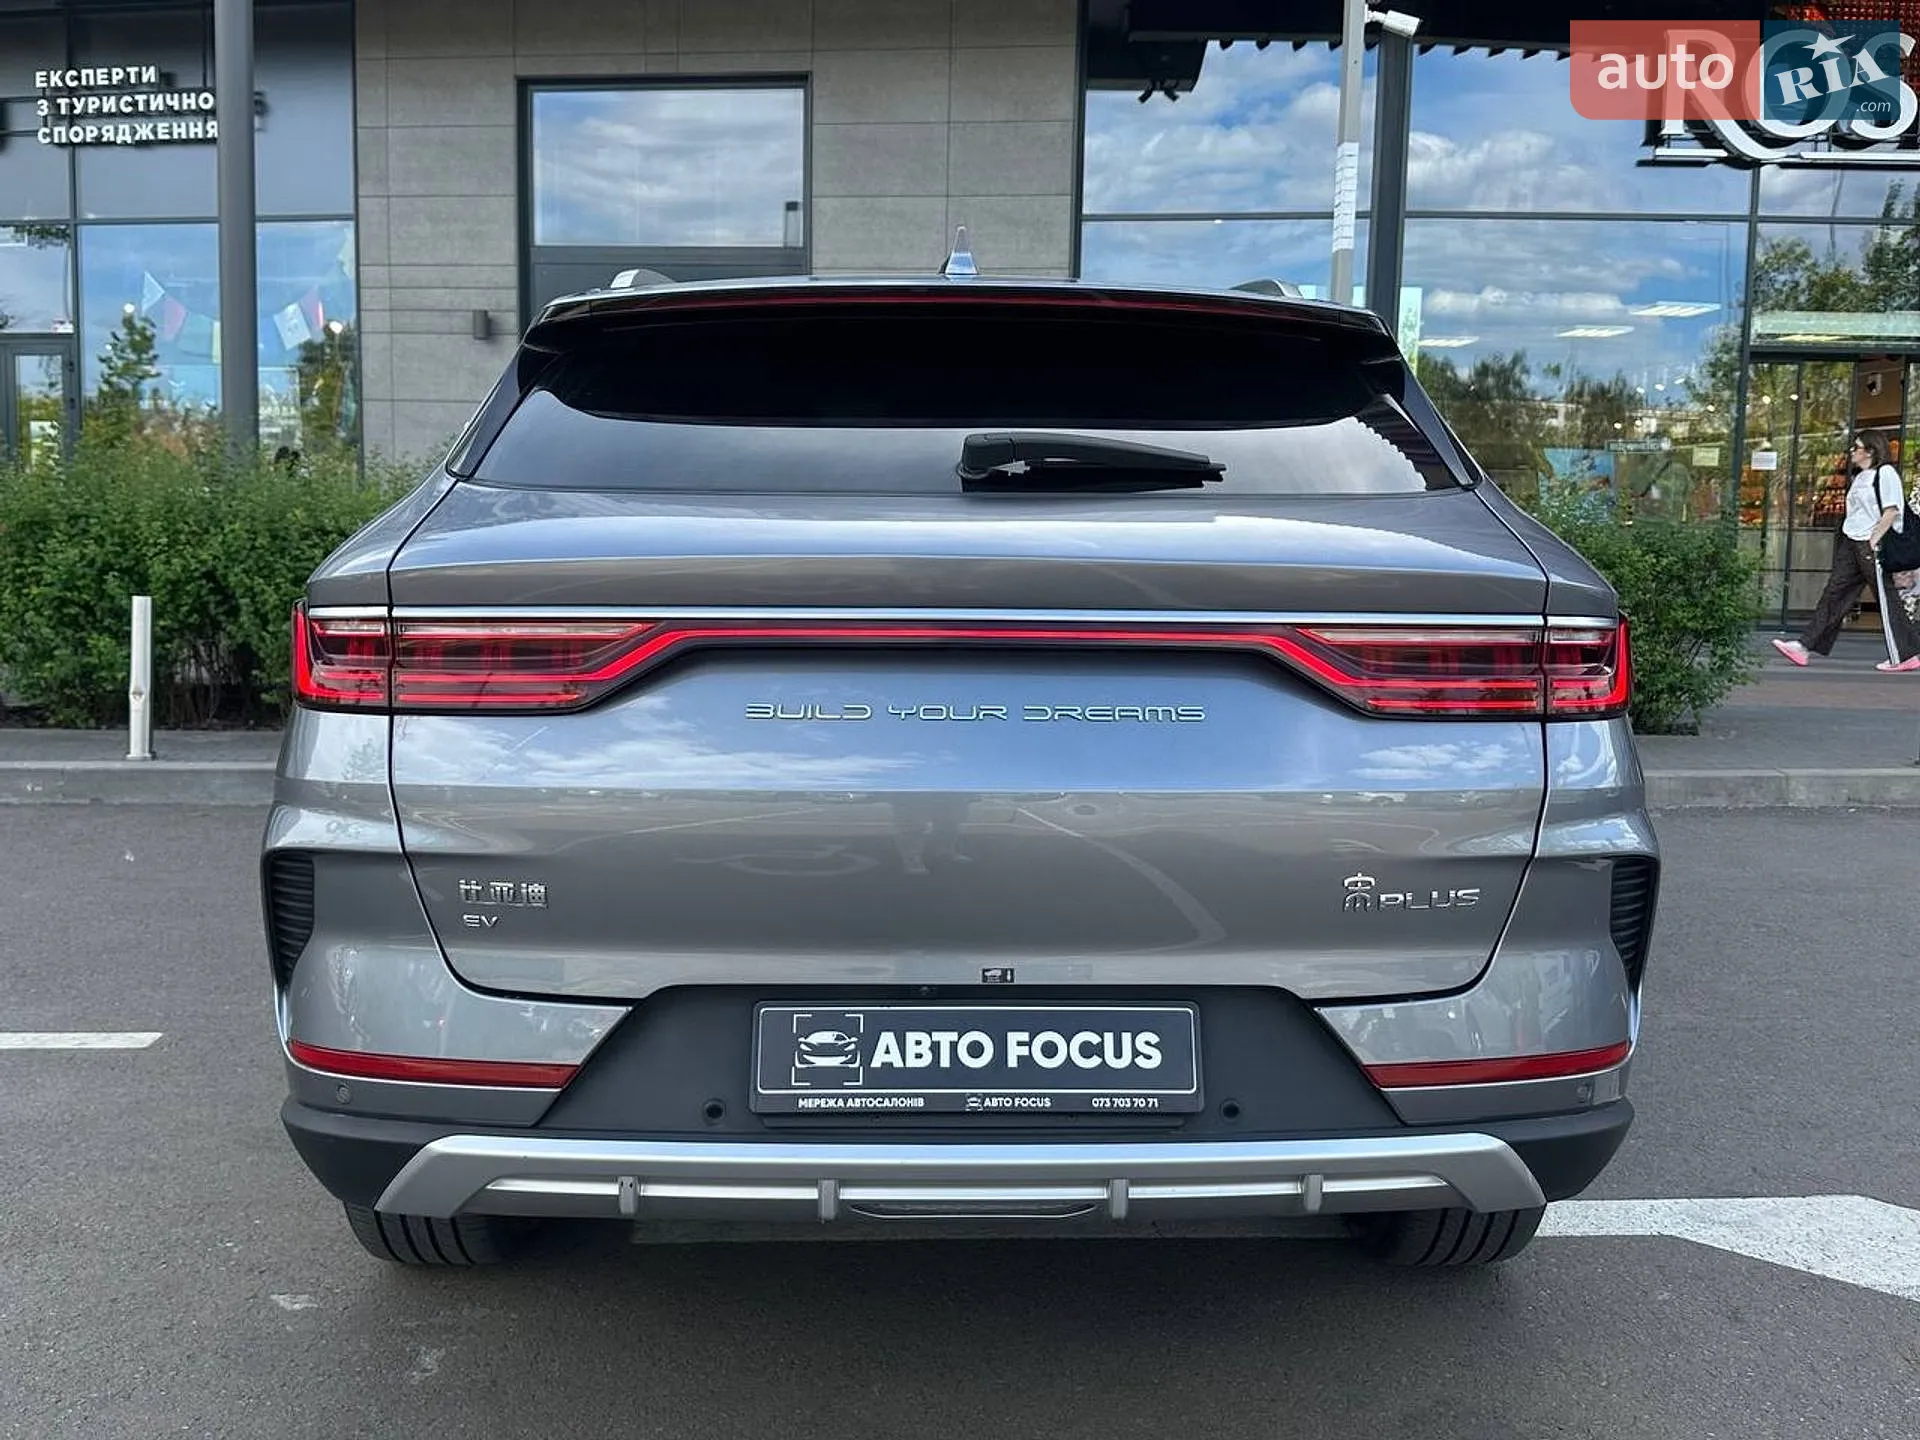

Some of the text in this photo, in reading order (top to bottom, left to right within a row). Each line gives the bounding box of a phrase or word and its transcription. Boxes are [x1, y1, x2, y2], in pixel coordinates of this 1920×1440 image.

[35, 65, 157, 89] ЕКСПЕРТИ
[56, 92, 215, 116] ТУРИСТИЧНО
[37, 120, 219, 145] СПОРЯДЖЕННЯ
[745, 702, 1206, 722] BUILD YOUR DREAMS
[1378, 888, 1481, 909] PLUS
[463, 914, 498, 927] EV
[870, 1030, 1163, 1070] АВТО FOCUS
[798, 1097, 925, 1109] МЕРЕЖА АВТОСАЛОНІВ
[984, 1096, 1052, 1108] АВТО FOCUS
[1091, 1097, 1159, 1109] 073 703 70 71
